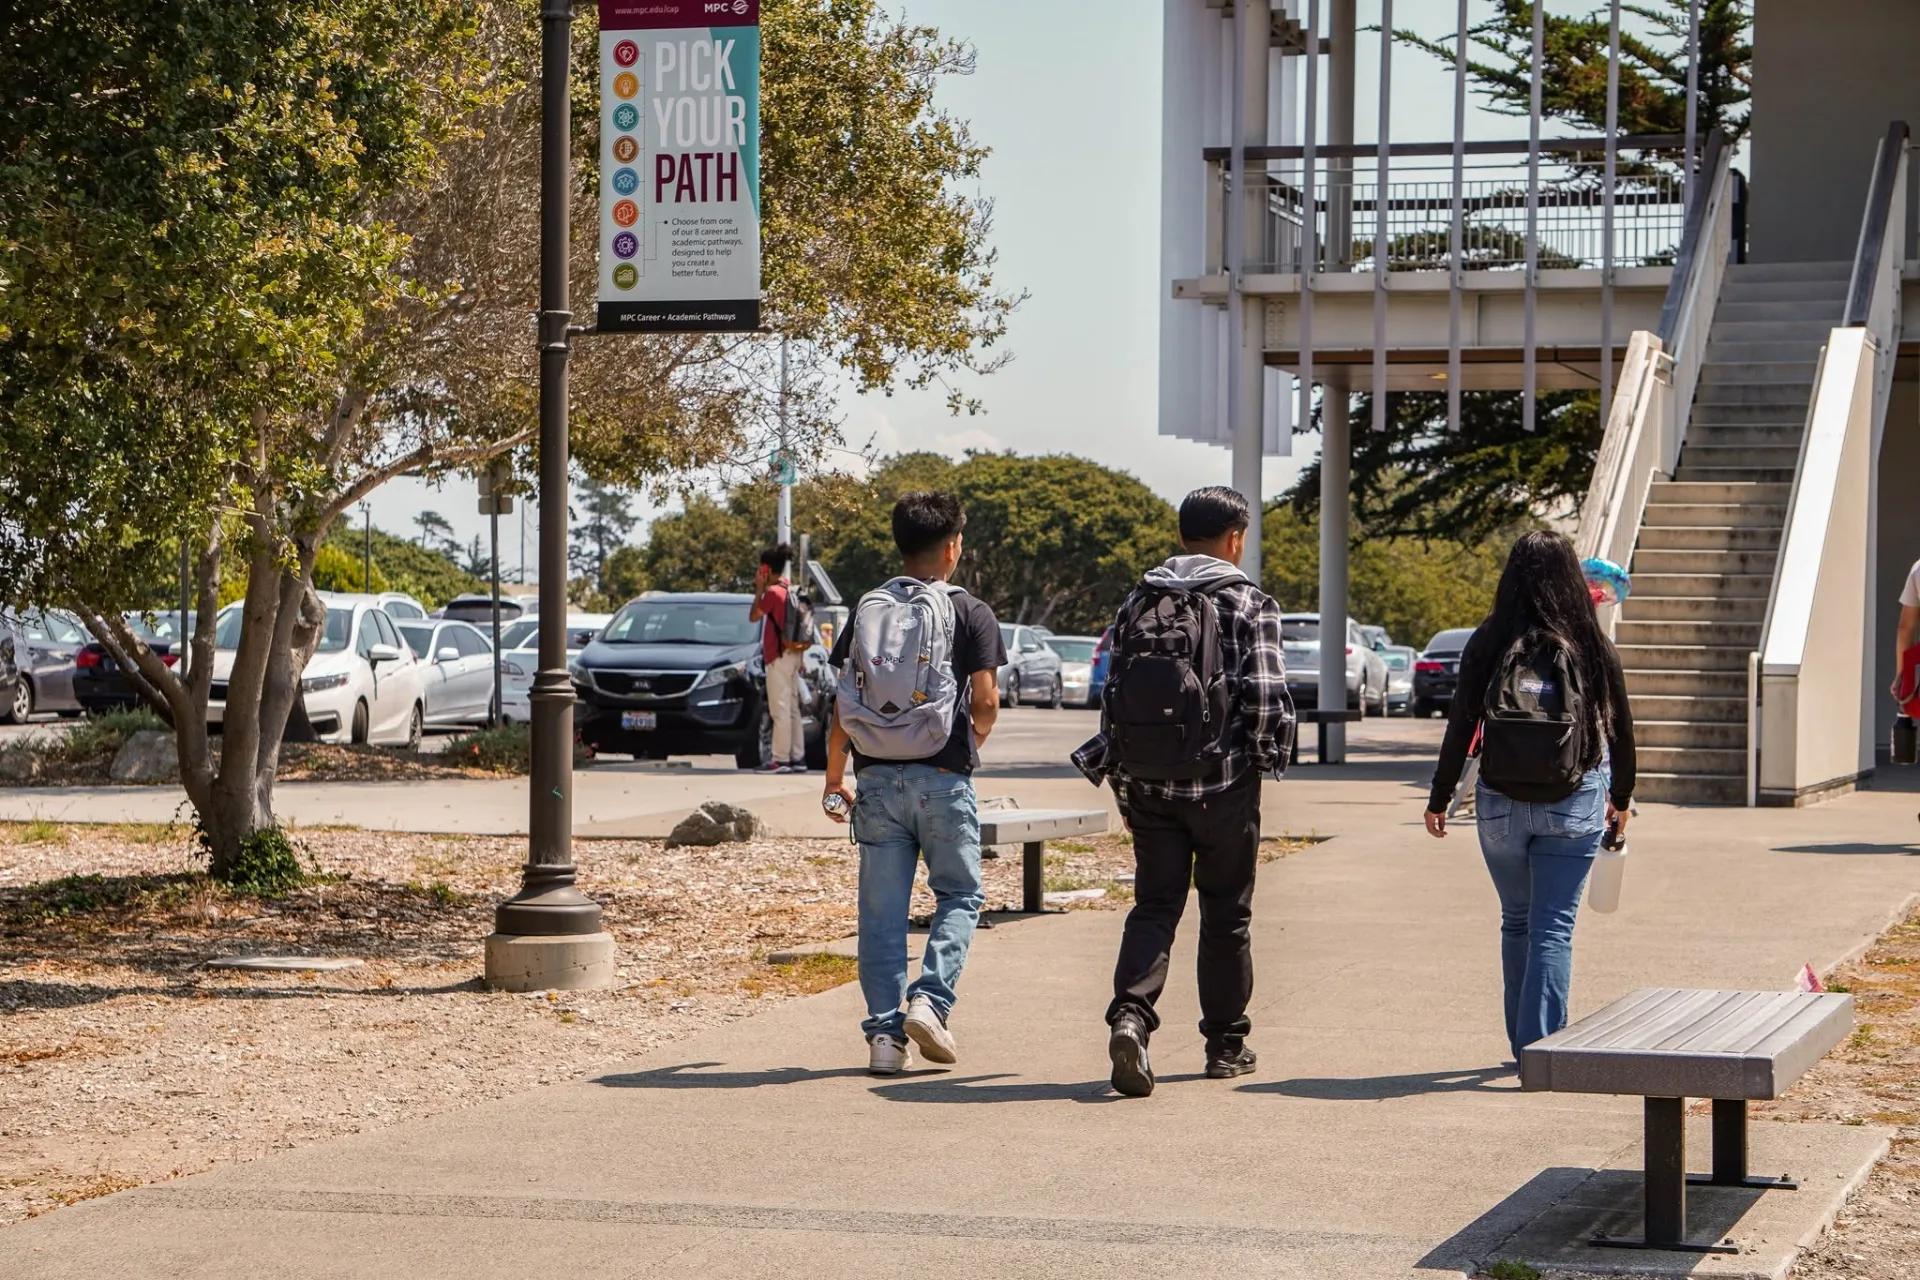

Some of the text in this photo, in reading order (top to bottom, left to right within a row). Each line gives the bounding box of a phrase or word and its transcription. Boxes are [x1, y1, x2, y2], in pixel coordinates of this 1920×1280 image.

[615, 4, 679, 15] www.mpc.edu/cap
[704, 3, 729, 13] MPC
[655, 39, 736, 92] PICK
[653, 96, 746, 148] YOUR
[655, 152, 737, 203] PATH
[671, 217, 699, 226] Choose
[700, 217, 717, 225] from
[671, 228, 680, 236] of
[694, 228, 700, 236] 8
[724, 227, 738, 235] and
[671, 238, 706, 246] academic
[671, 248, 705, 257] designed
[715, 248, 732, 257] help
[671, 260, 686, 268] you
[671, 268, 720, 277] better future.
[620, 312, 736, 322] MPC Career Academic Pathways
[884, 656, 905, 664] MPC
